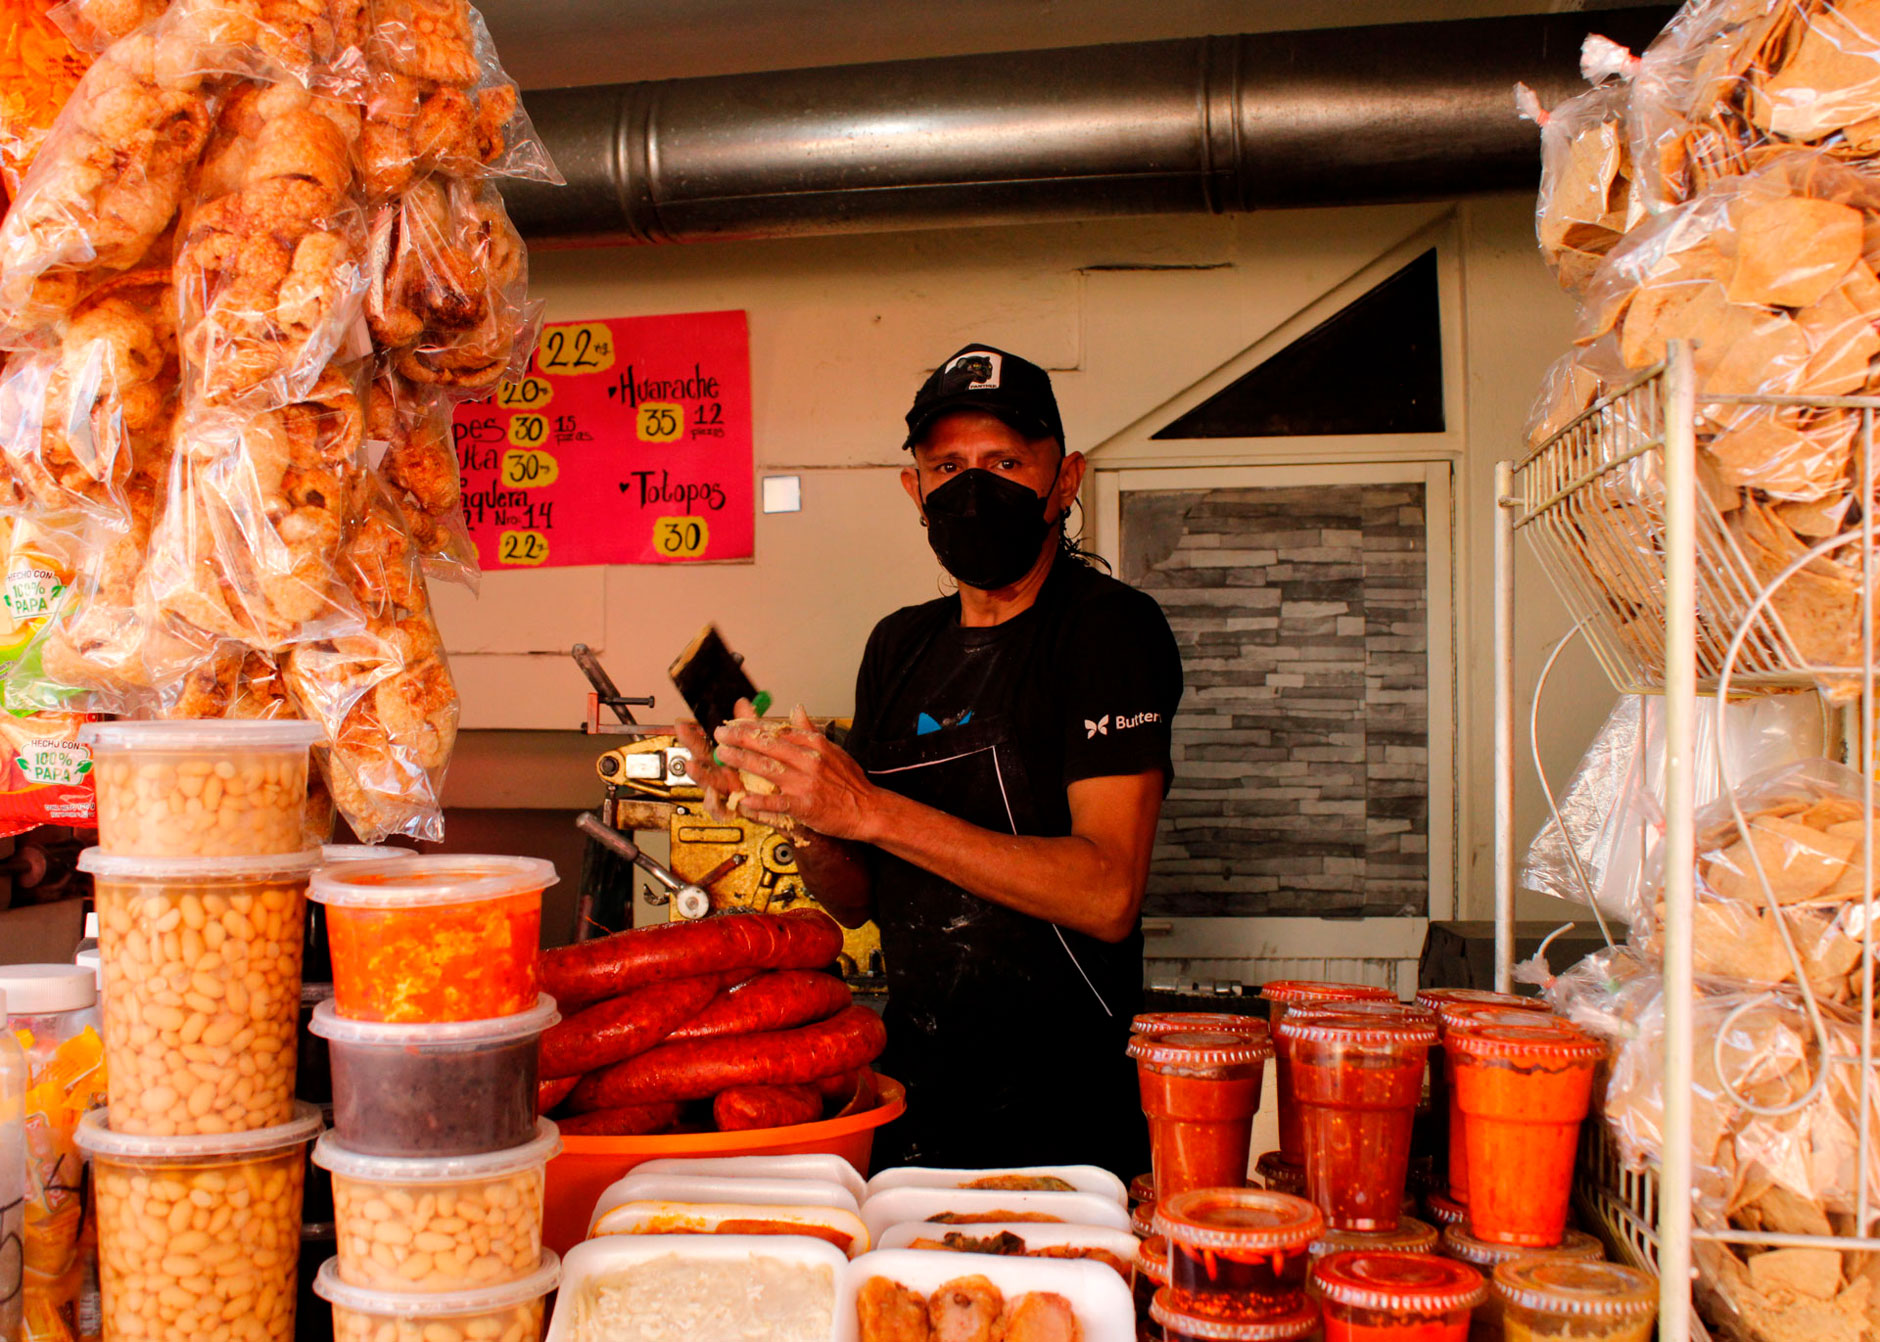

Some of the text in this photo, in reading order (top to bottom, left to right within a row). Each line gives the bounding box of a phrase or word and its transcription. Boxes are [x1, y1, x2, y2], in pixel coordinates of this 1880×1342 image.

[546, 328, 599, 368] 22
[503, 378, 539, 404] 20
[620, 362, 720, 409] Huarache
[553, 415, 577, 432] 15
[643, 408, 677, 437] 35
[693, 402, 725, 425] 12
[514, 416, 543, 441] 30
[508, 454, 539, 482] 30
[630, 468, 727, 515] Totopos
[521, 502, 554, 529] 14
[504, 534, 540, 560] 22
[664, 522, 701, 552] 30
[33, 569, 53, 579] CON
[13, 581, 46, 599] 100%
[15, 597, 48, 614] PAPA
[31, 739, 80, 750] HECHO CON
[35, 752, 73, 767] 100%
[34, 766, 71, 782] PAPA
